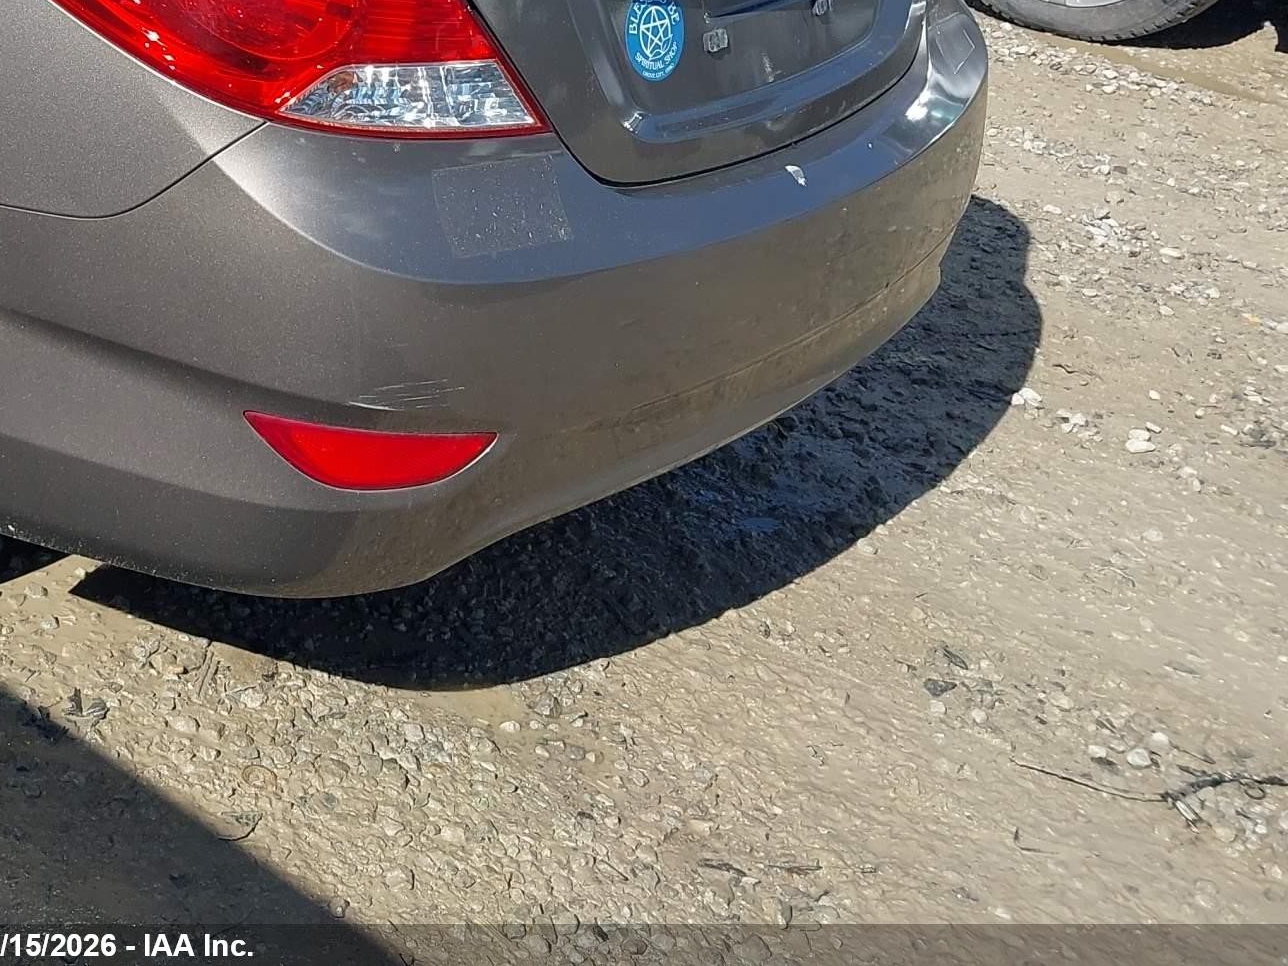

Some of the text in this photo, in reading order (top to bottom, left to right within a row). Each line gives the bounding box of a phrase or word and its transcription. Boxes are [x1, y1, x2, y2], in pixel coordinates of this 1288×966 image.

[667, 1, 680, 25] BE
[634, 40, 678, 71] SPIRITUAL SHOP
